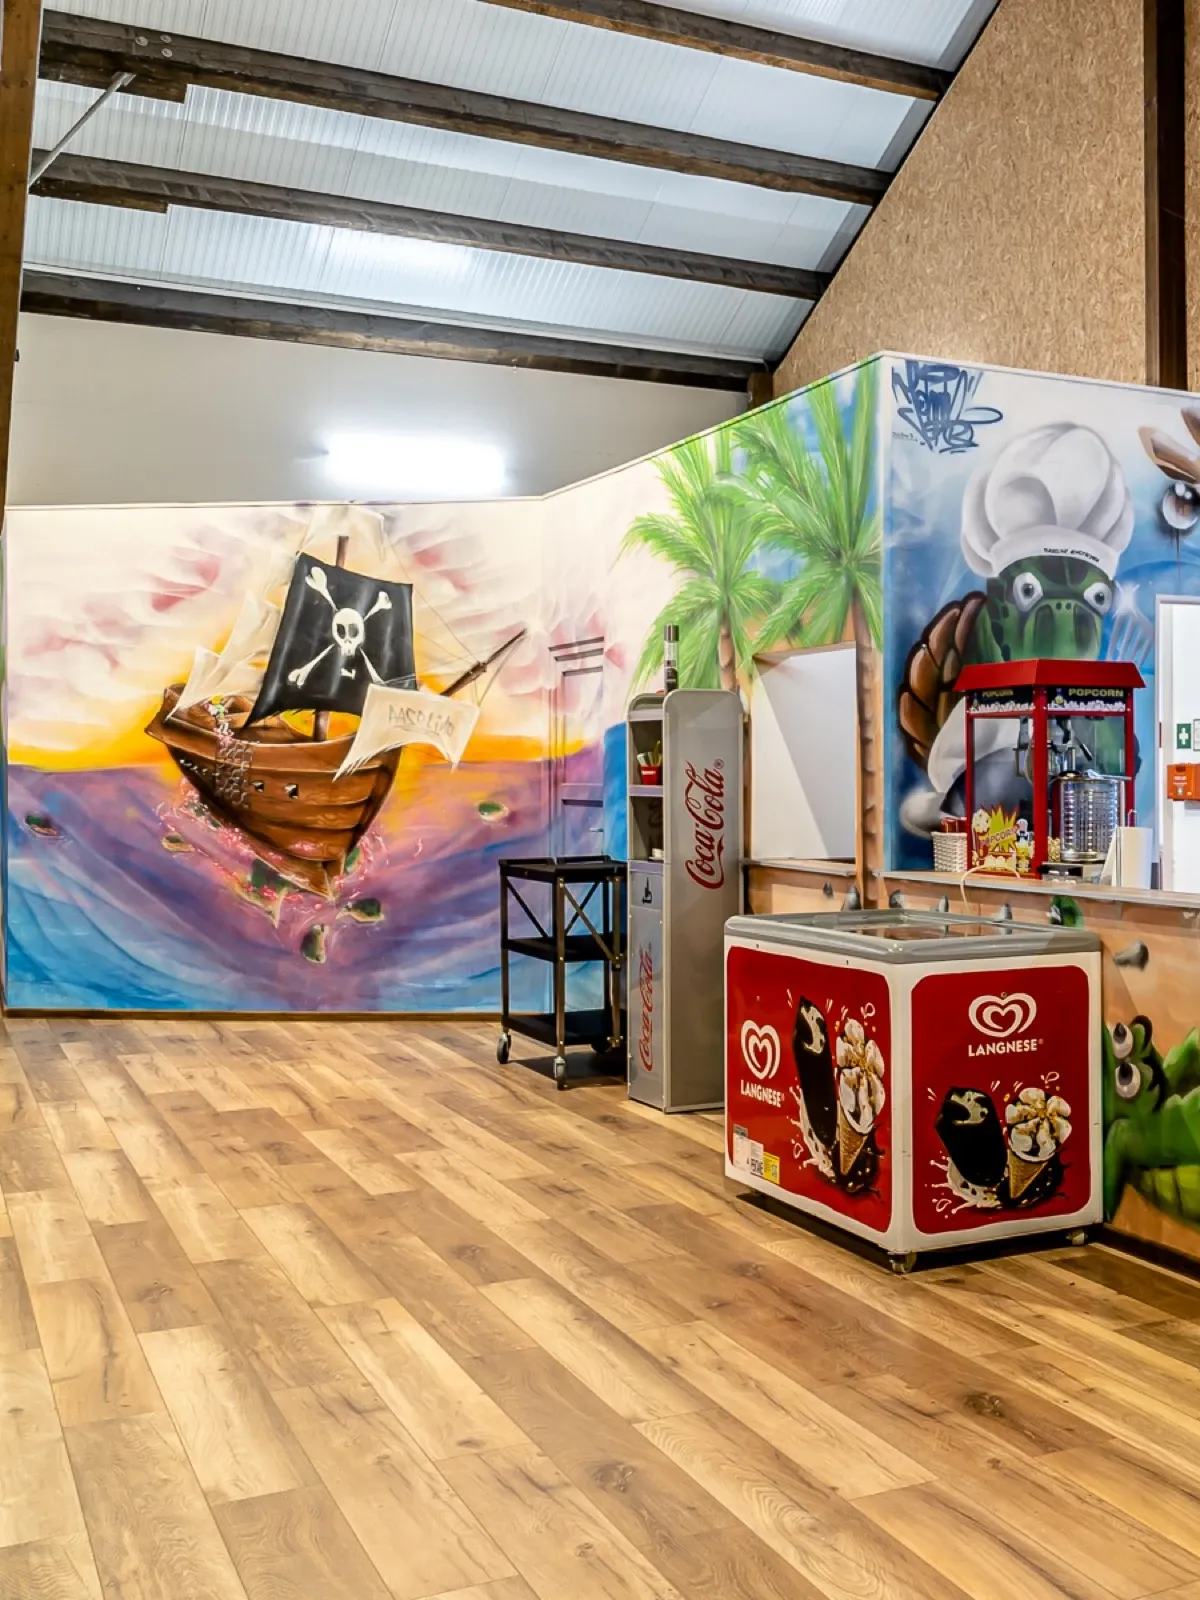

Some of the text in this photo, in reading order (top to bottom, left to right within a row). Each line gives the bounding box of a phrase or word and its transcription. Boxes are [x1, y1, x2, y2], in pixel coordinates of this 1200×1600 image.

[982, 689, 1014, 697] POPCORN
[1068, 688, 1124, 697] POPCORN
[685, 759, 724, 889] Coca-Cola
[639, 942, 653, 1072] Coca-Cola
[968, 1039, 1037, 1057] LANGNESE
[741, 1079, 782, 1108] LANGNESE
